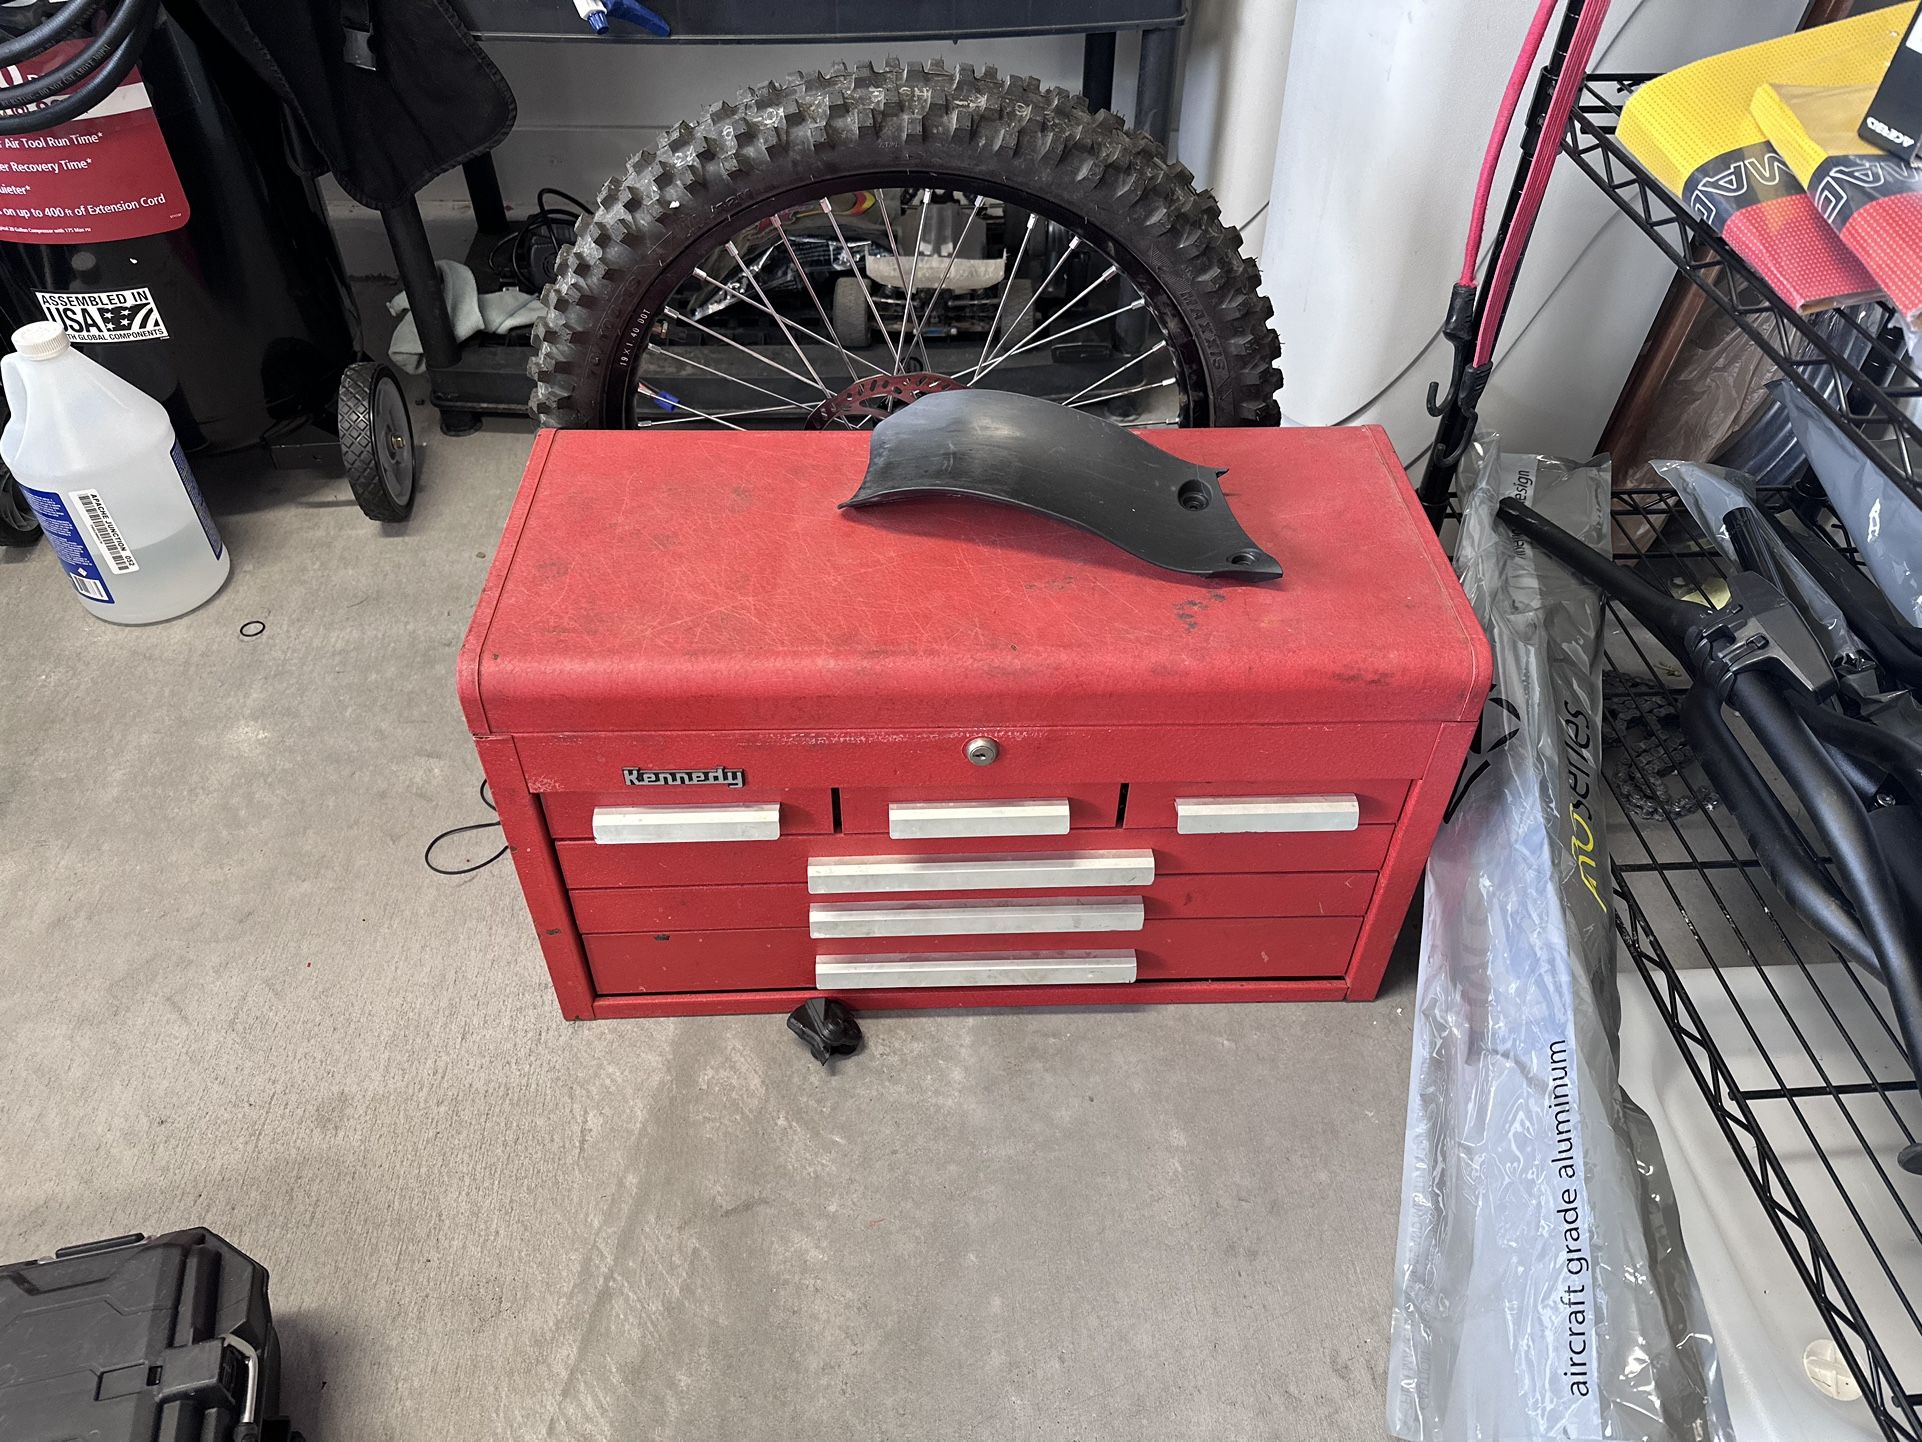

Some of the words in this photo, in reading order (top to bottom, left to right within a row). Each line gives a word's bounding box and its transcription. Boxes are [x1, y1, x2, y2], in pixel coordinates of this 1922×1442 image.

[4, 137, 20, 149] Air
[20, 137, 46, 149] Tool
[46, 136, 70, 147] Run
[10, 161, 59, 174] Recovery
[3, 208, 16, 217] on
[16, 208, 30, 219] up
[31, 208, 43, 217] to
[44, 207, 64, 218] 400
[64, 208, 73, 217] ft
[74, 205, 86, 216] of
[87, 200, 139, 215] Extension
[140, 193, 166, 207] Cord
[41, 293, 127, 307] ASSEMBLED
[131, 290, 149, 303] IN
[46, 307, 104, 333] USA
[109, 328, 164, 340] COMPONENTS
[1513, 470, 1533, 503] esign
[90, 493, 110, 520] APACHE
[105, 521, 127, 552] JUNCTION
[125, 555, 136, 567] 052
[622, 766, 744, 788] Kennedy
[1548, 1039, 1576, 1179] aluminum
[1556, 1188, 1589, 1275] grade
[1560, 1284, 1589, 1397] aircraft
